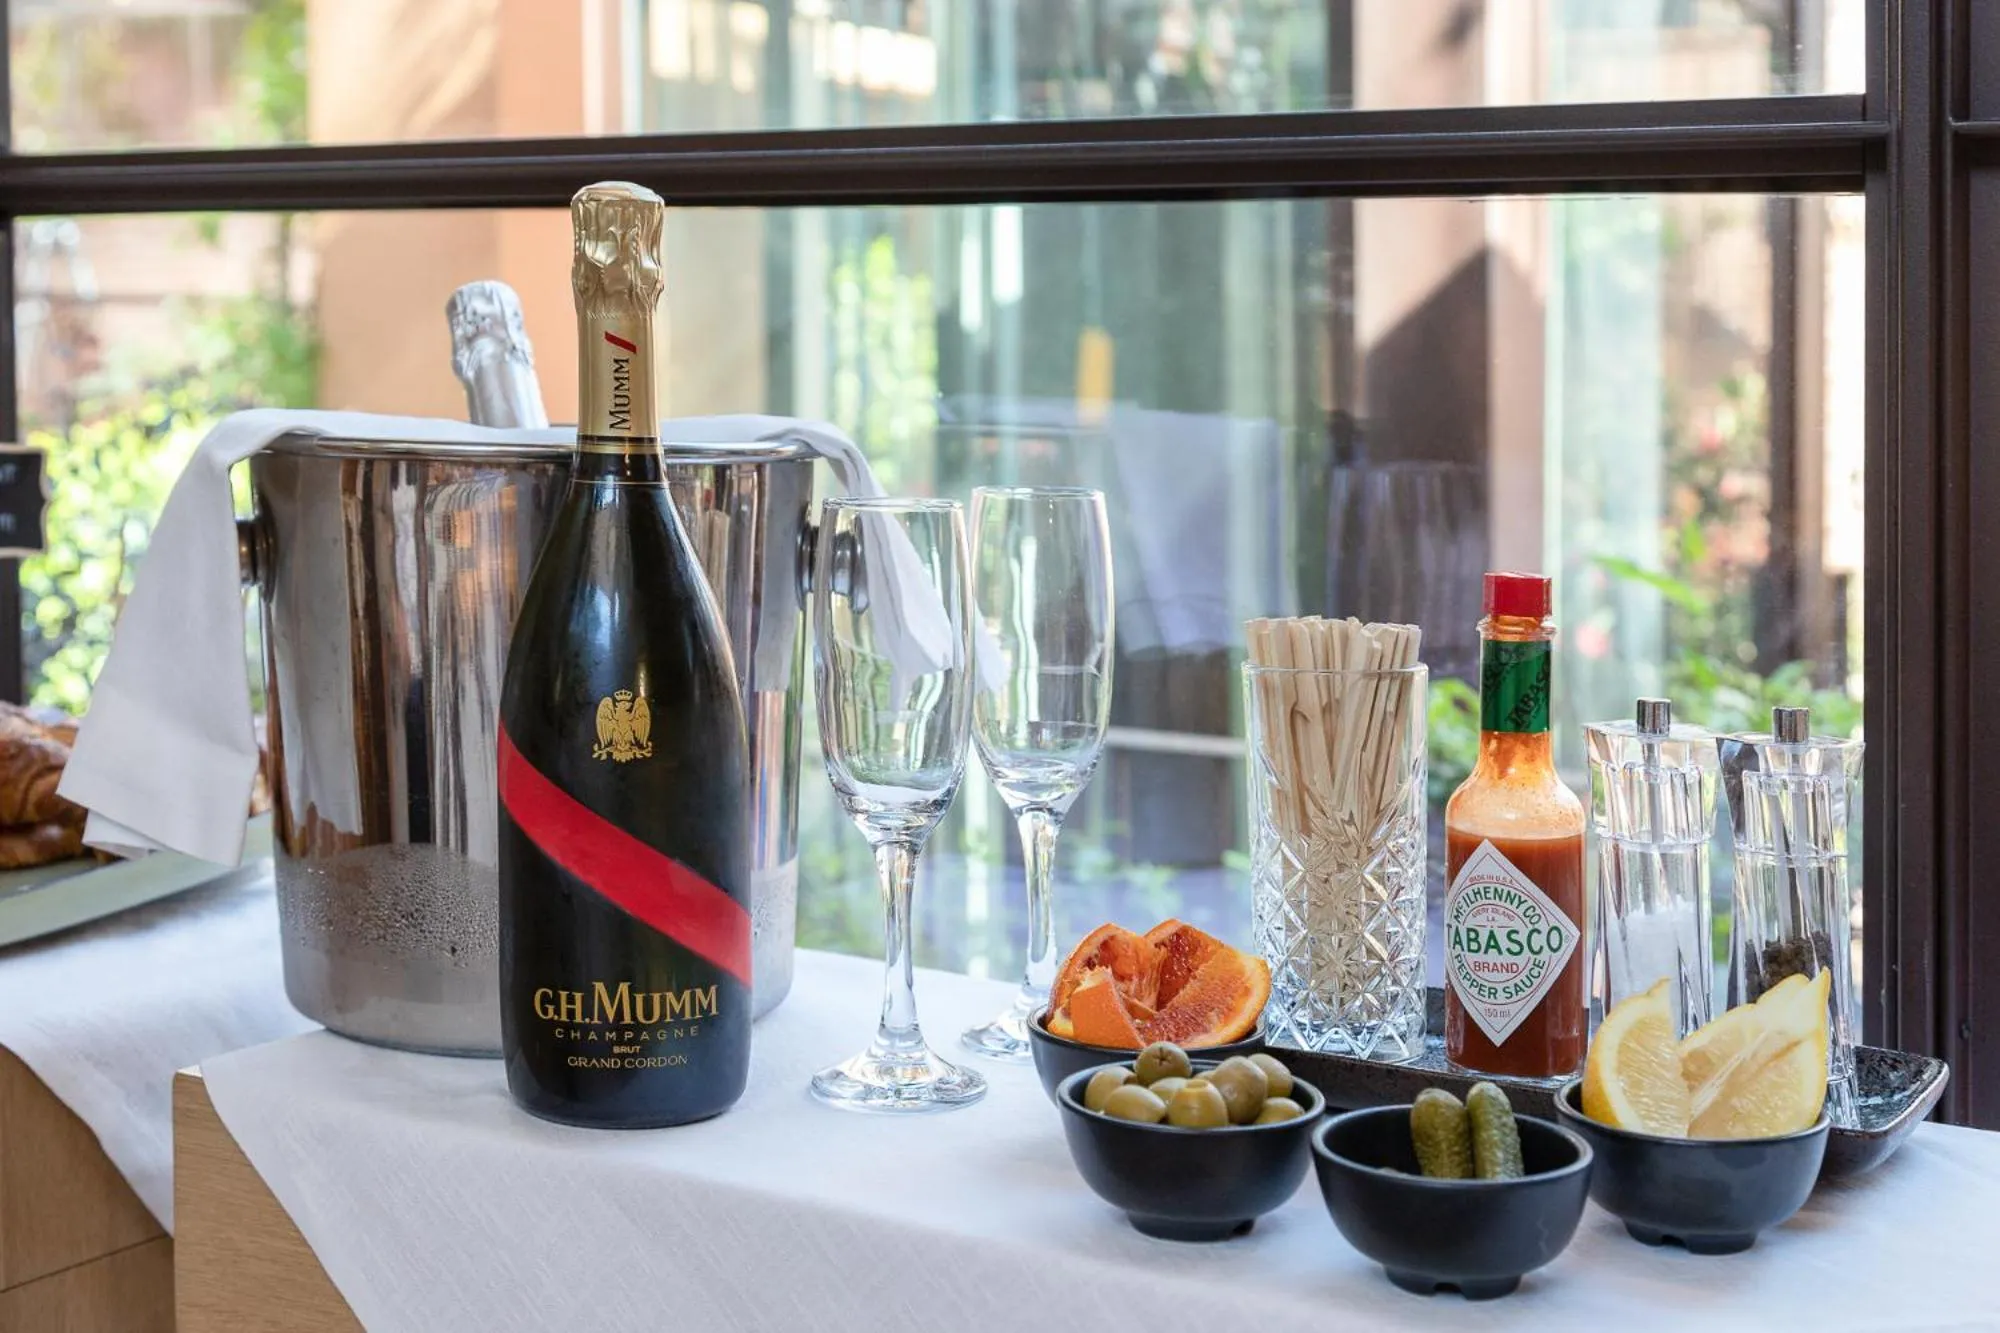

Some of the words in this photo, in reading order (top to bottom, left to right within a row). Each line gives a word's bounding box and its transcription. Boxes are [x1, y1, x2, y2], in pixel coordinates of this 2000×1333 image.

[1473, 961, 1520, 974] BRAND
[1455, 954, 1499, 1000] PEPPER
[1503, 957, 1546, 1000] SAUCE
[555, 1026, 699, 1041] CHAMPAGNE
[613, 1046, 641, 1054] BRUT
[568, 1056, 620, 1069] GRAND
[625, 1055, 688, 1069] CORDON
